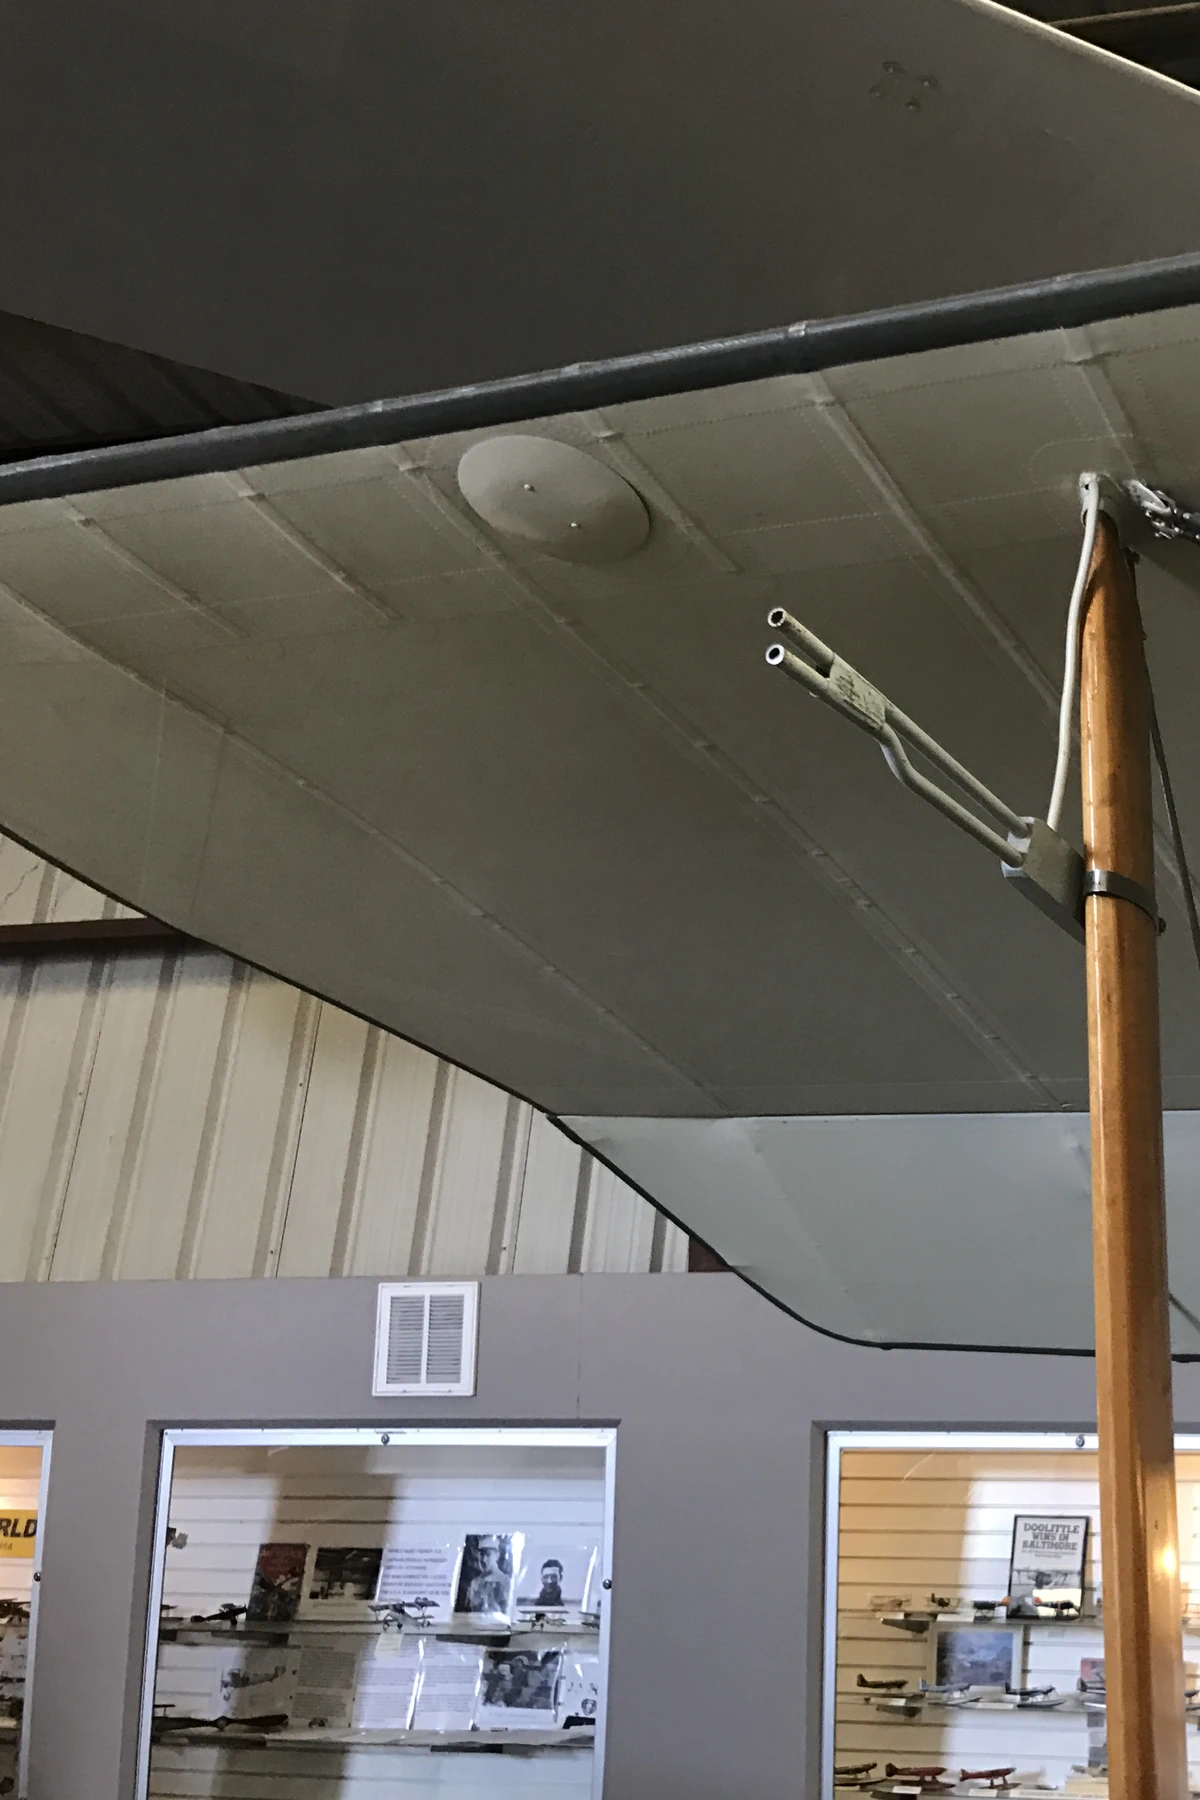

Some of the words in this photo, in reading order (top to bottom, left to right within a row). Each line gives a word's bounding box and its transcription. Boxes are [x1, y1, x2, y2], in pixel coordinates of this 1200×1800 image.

[1023, 1522, 1081, 1534] DOOLITTLE
[1032, 1531, 1057, 1541] WINS
[1058, 1532, 1070, 1542] IN
[1022, 1540, 1079, 1551] BALTIMORE
